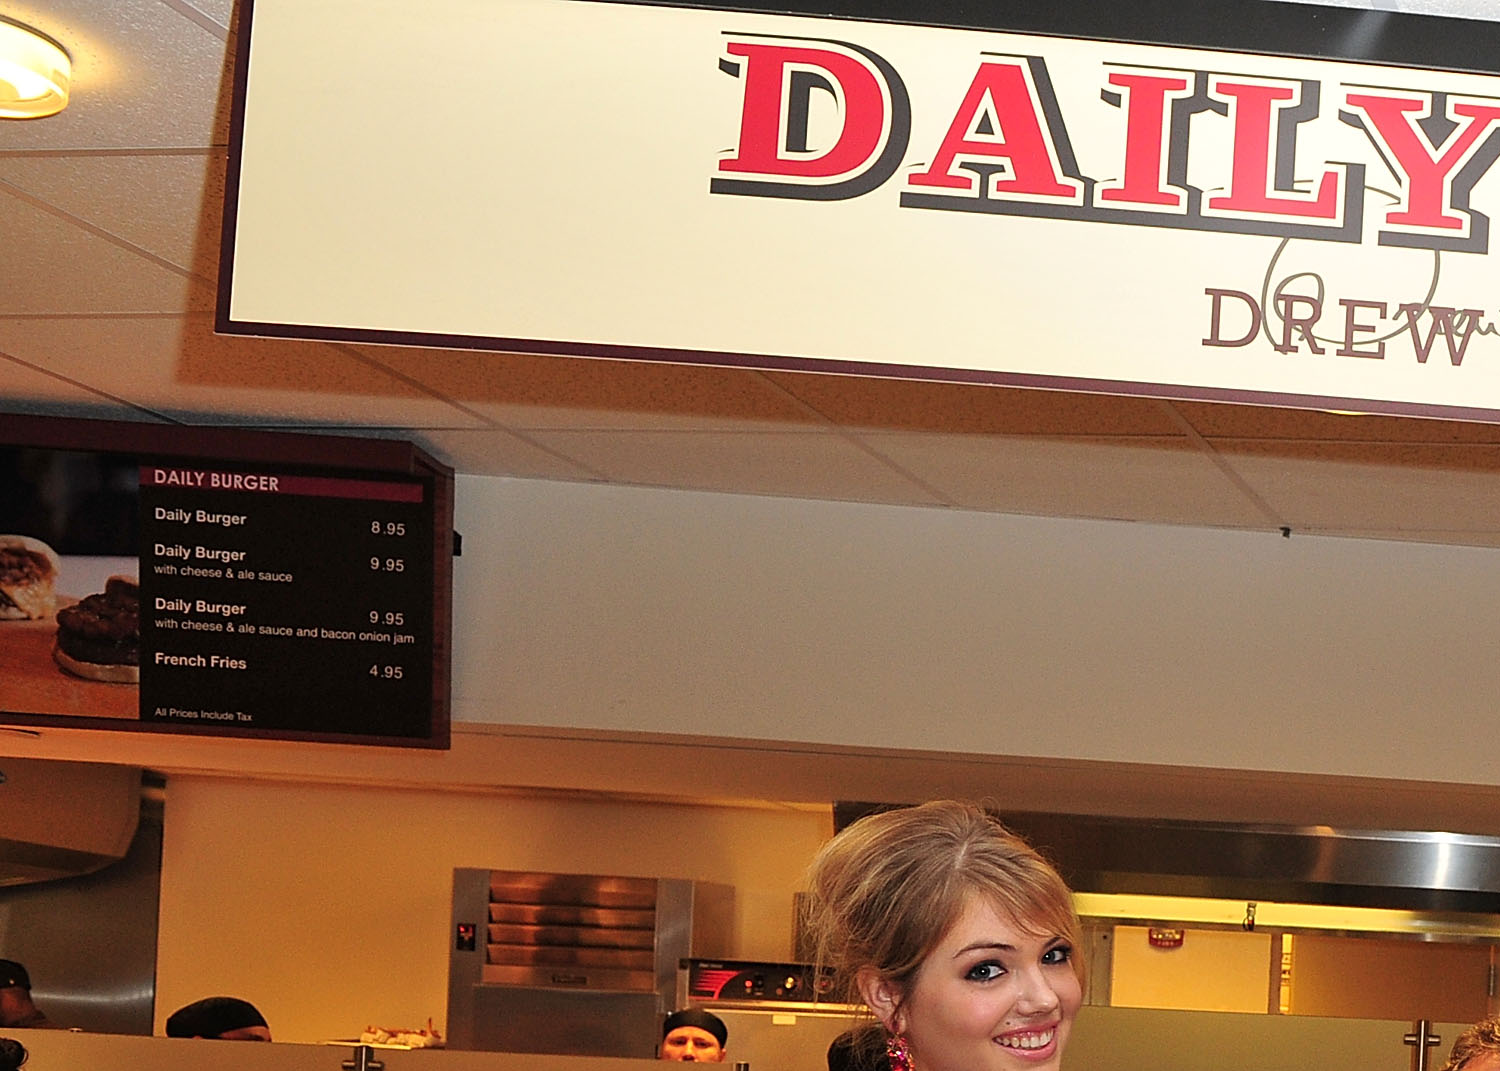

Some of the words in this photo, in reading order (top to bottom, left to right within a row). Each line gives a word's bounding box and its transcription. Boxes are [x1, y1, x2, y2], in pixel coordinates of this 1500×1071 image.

[1202, 288, 1484, 367] DREW
[154, 469, 205, 486] DAILY
[210, 473, 280, 492] BURGER
[154, 507, 191, 524] Daily
[196, 510, 247, 527] Burger
[371, 521, 406, 536] 8.95
[154, 543, 191, 560] Daily
[195, 546, 246, 563] Burger
[370, 557, 405, 572] 9.95
[154, 564, 177, 576] with
[180, 565, 222, 578] cheese
[225, 568, 234, 579] &
[237, 568, 255, 580] ale
[258, 571, 293, 582] sauce
[155, 597, 191, 615] Daily
[195, 600, 246, 616] Burger
[369, 611, 404, 626] 9.95
[155, 618, 178, 629] with
[181, 620, 223, 632] cheese
[226, 622, 235, 633] &
[238, 622, 256, 634] ale
[258, 625, 293, 636] sauce
[296, 626, 318, 638] and
[321, 628, 356, 640] bacon
[359, 631, 390, 642] onion
[393, 632, 415, 645] jam
[155, 652, 206, 668] French
[210, 655, 247, 670] Fries
[369, 664, 403, 679] 4.95
[154, 707, 167, 718] All
[169, 708, 198, 719] Prices
[200, 710, 234, 721] Include
[237, 711, 252, 722] Tax
